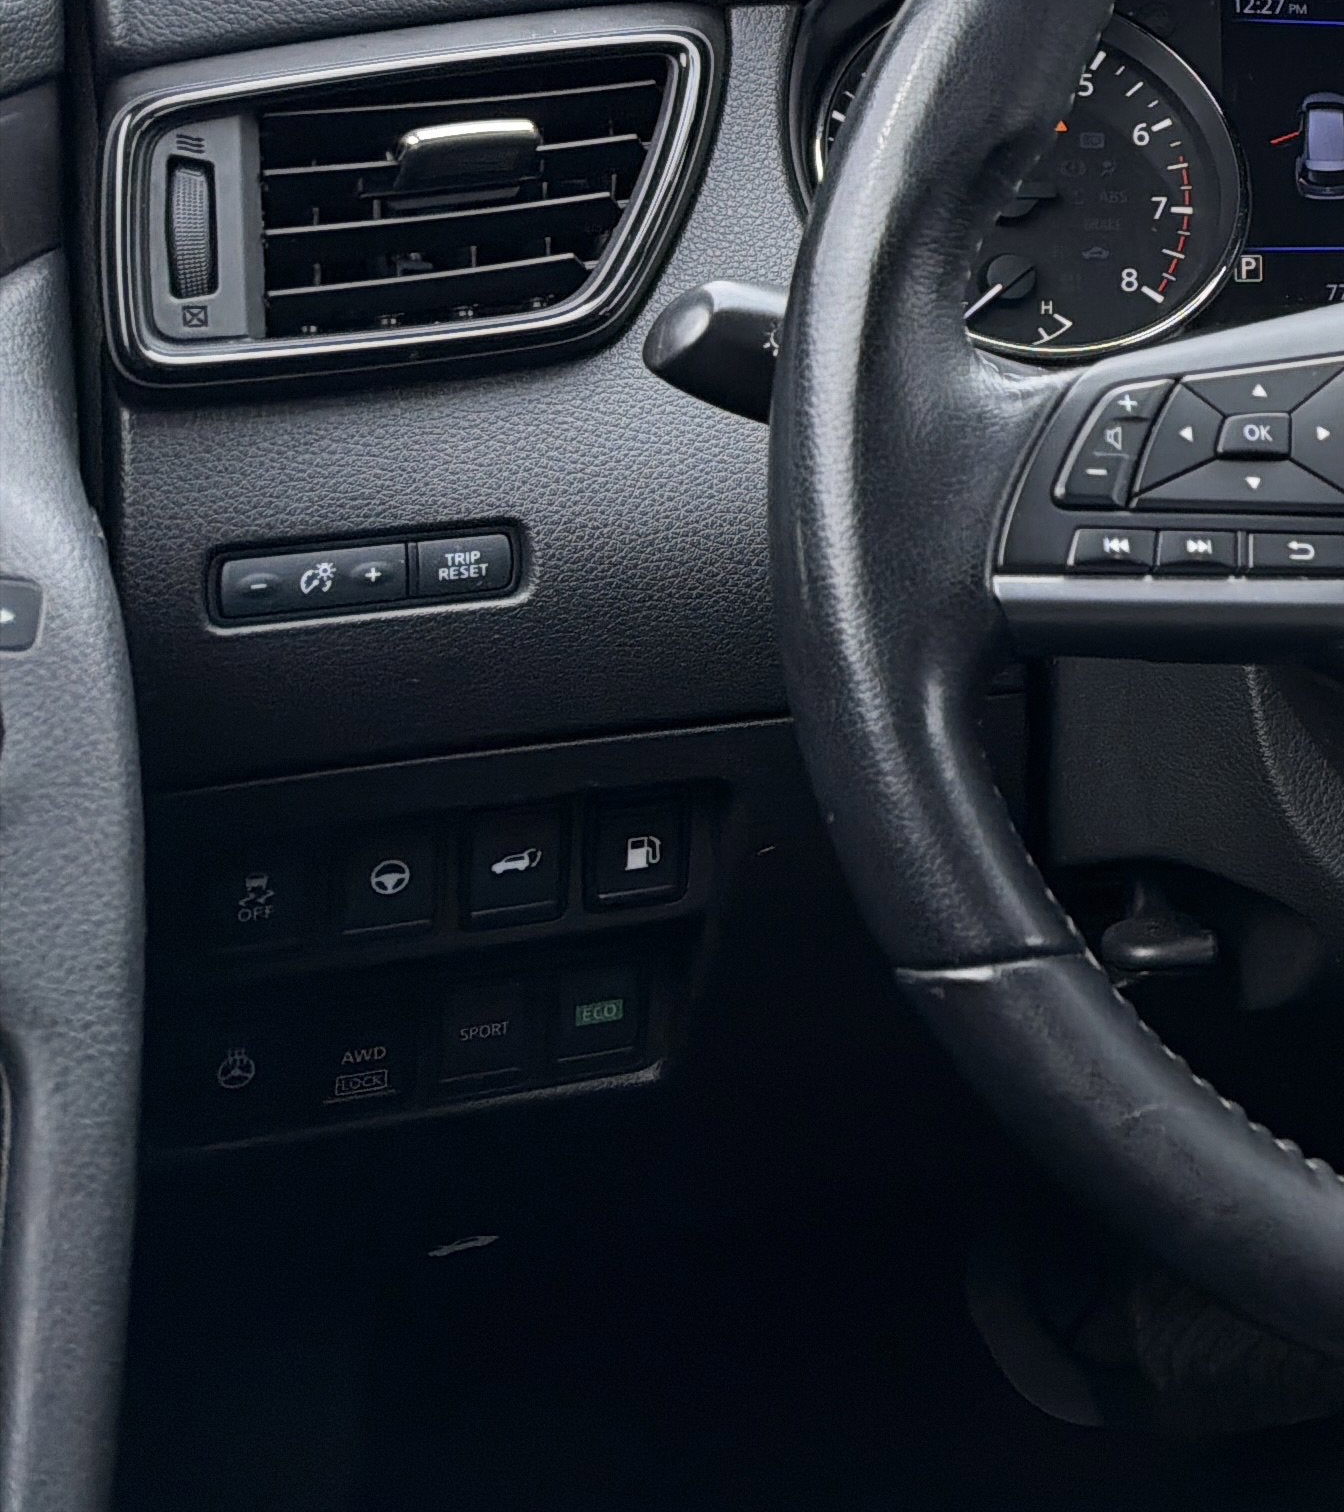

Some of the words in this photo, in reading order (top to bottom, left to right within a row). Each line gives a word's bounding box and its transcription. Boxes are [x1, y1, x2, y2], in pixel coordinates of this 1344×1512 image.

[1288, 3, 1308, 15] PM
[1078, 74, 1094, 97] 5
[1133, 122, 1149, 146] 6
[1151, 196, 1167, 219] 7
[1240, 257, 1257, 280] P
[1121, 268, 1138, 292] 8
[1041, 300, 1053, 315] H
[1242, 424, 1273, 442] OK
[444, 550, 482, 566] TRIP
[438, 562, 489, 581] RESET
[238, 903, 274, 923] OFF
[581, 1002, 617, 1022] ECO
[459, 1020, 509, 1042] SPORT
[341, 1045, 387, 1067] AWD
[341, 1072, 383, 1092] LOCK
